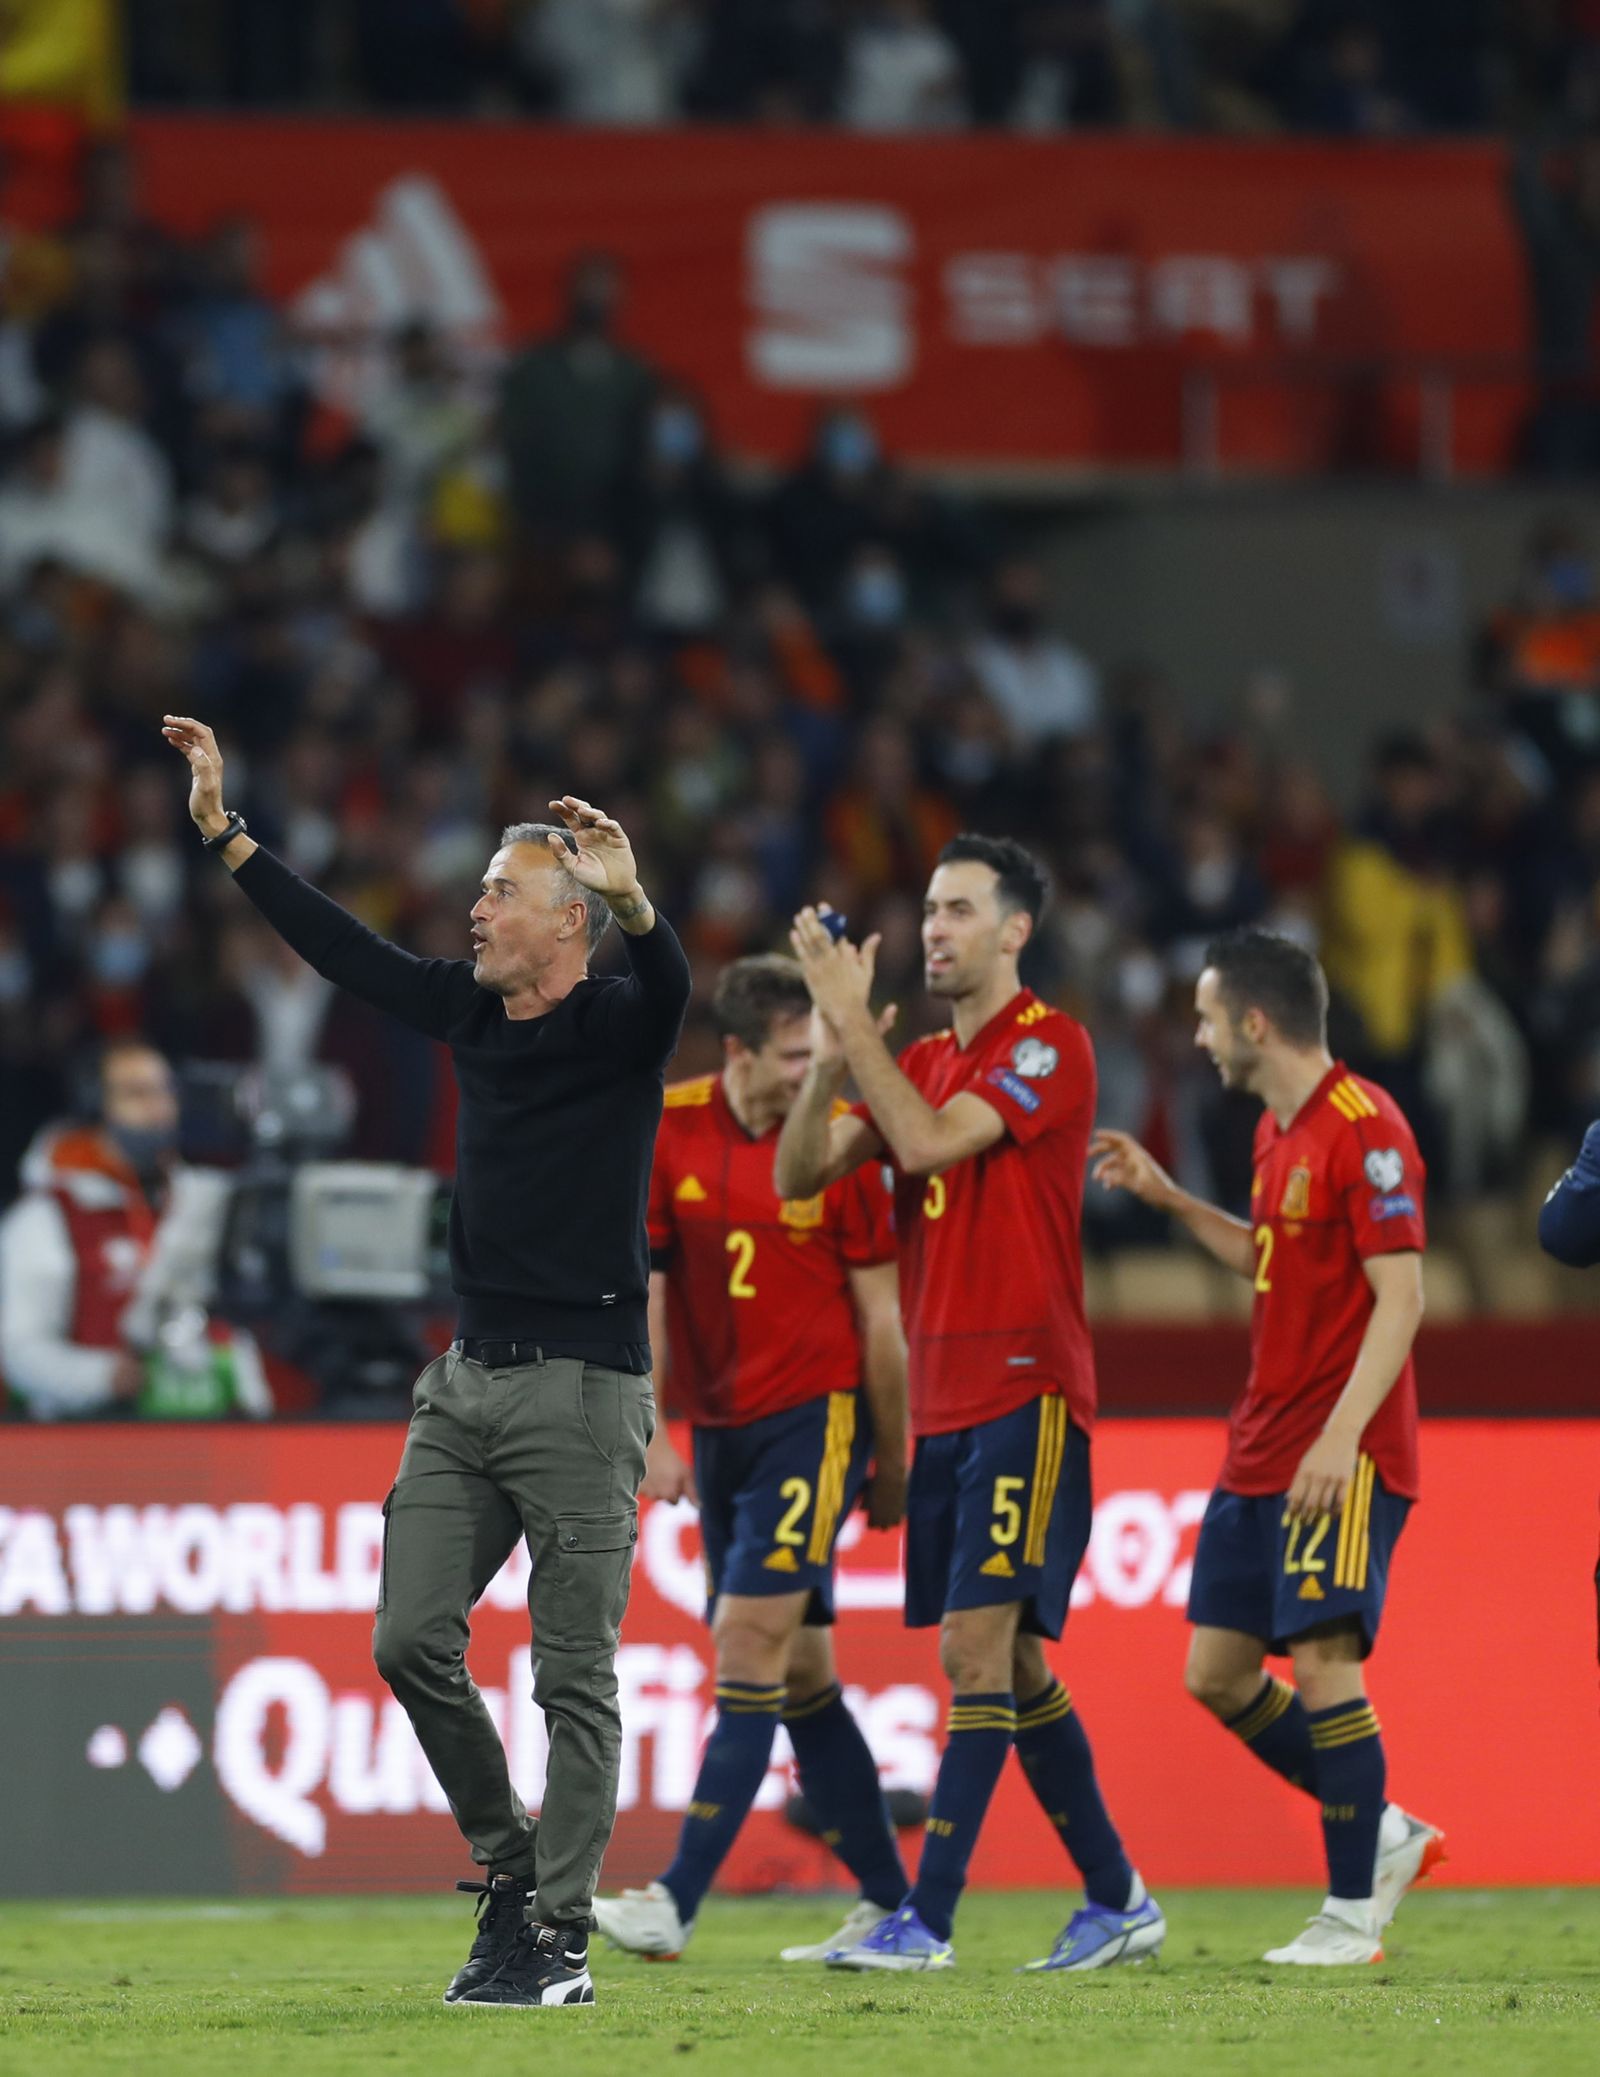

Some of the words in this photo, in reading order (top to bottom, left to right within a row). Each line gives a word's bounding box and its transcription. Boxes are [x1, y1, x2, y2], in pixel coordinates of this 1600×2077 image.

[942, 251, 1332, 346] SEAT
[726, 1230, 755, 1297] 2
[775, 1477, 811, 1546] 2
[990, 1476, 1024, 1546] 5
[1281, 1508, 1330, 1574] 22
